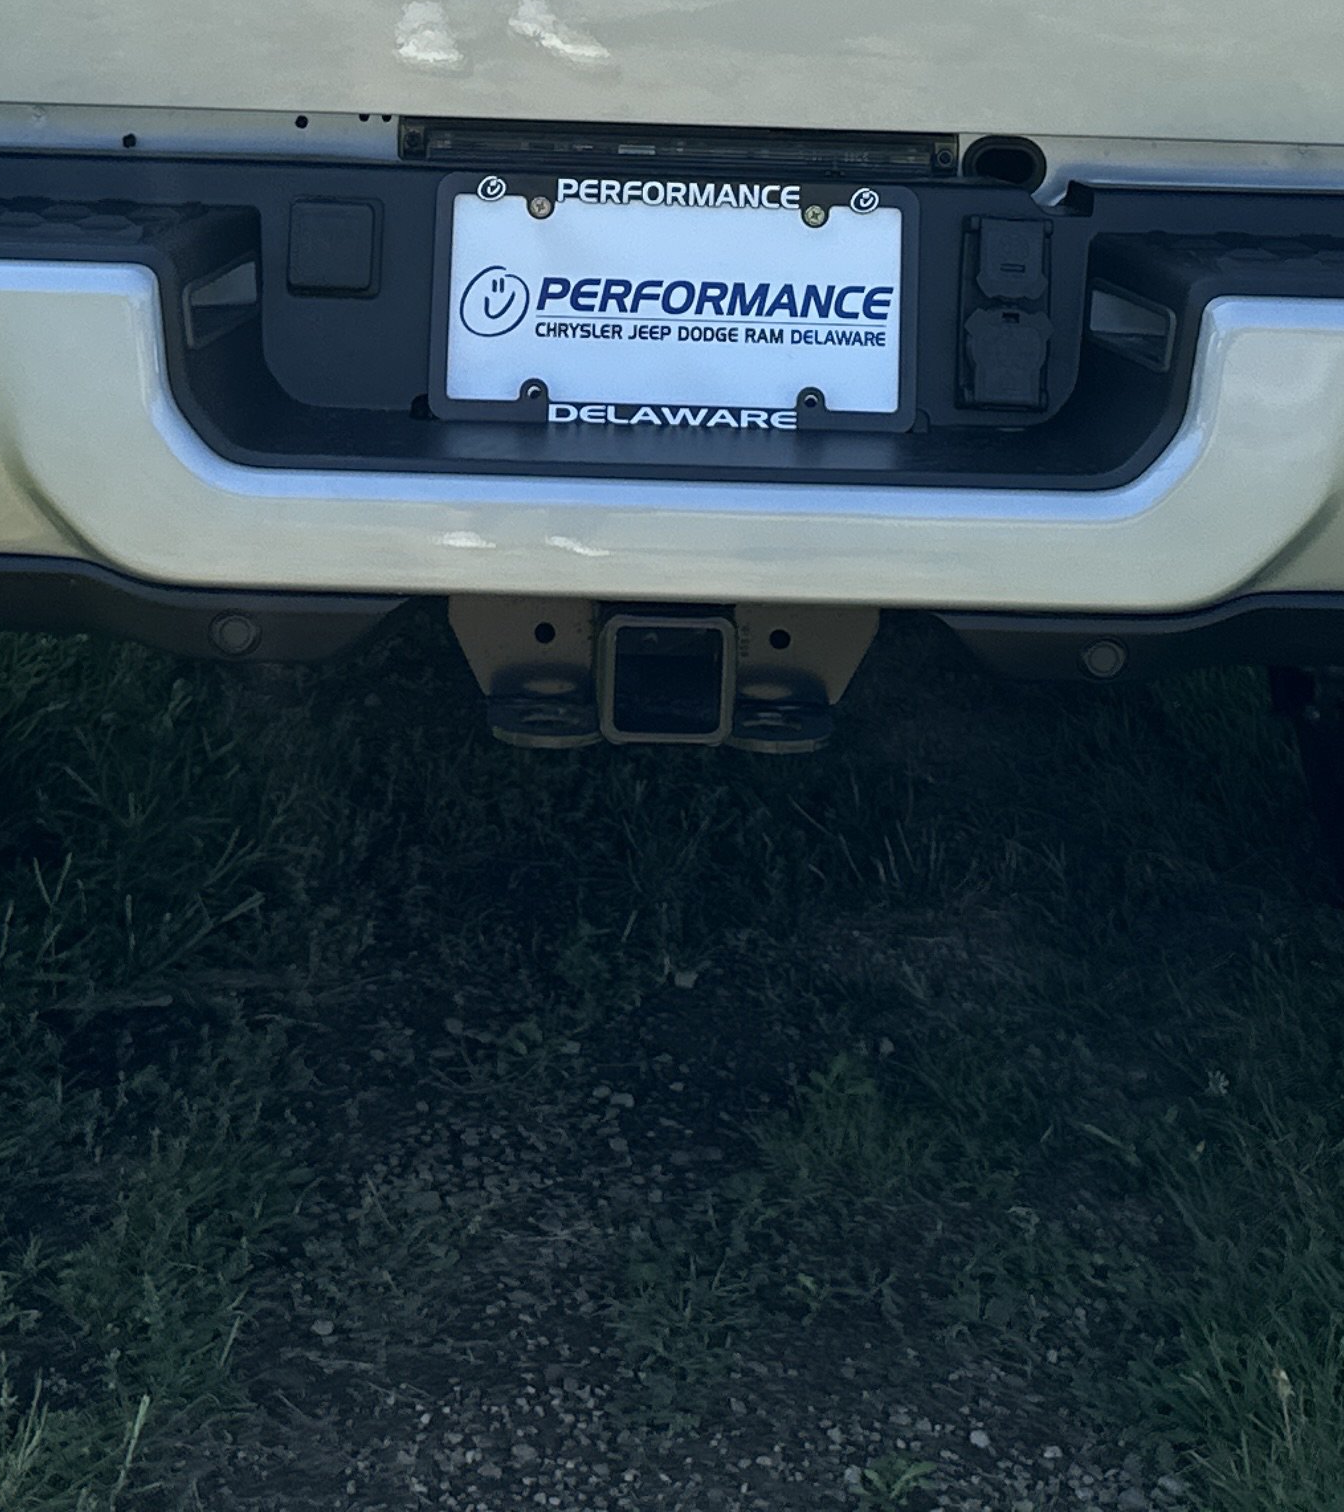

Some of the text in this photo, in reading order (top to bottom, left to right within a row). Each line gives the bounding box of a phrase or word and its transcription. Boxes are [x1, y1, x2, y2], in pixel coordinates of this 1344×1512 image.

[557, 178, 801, 209] PERFORMANCE
[536, 277, 894, 320] PERFORMANCE
[535, 322, 886, 346] CHRYSLER JEEP DODGE RAM DELAWARE
[548, 404, 797, 429] DELAWARE
